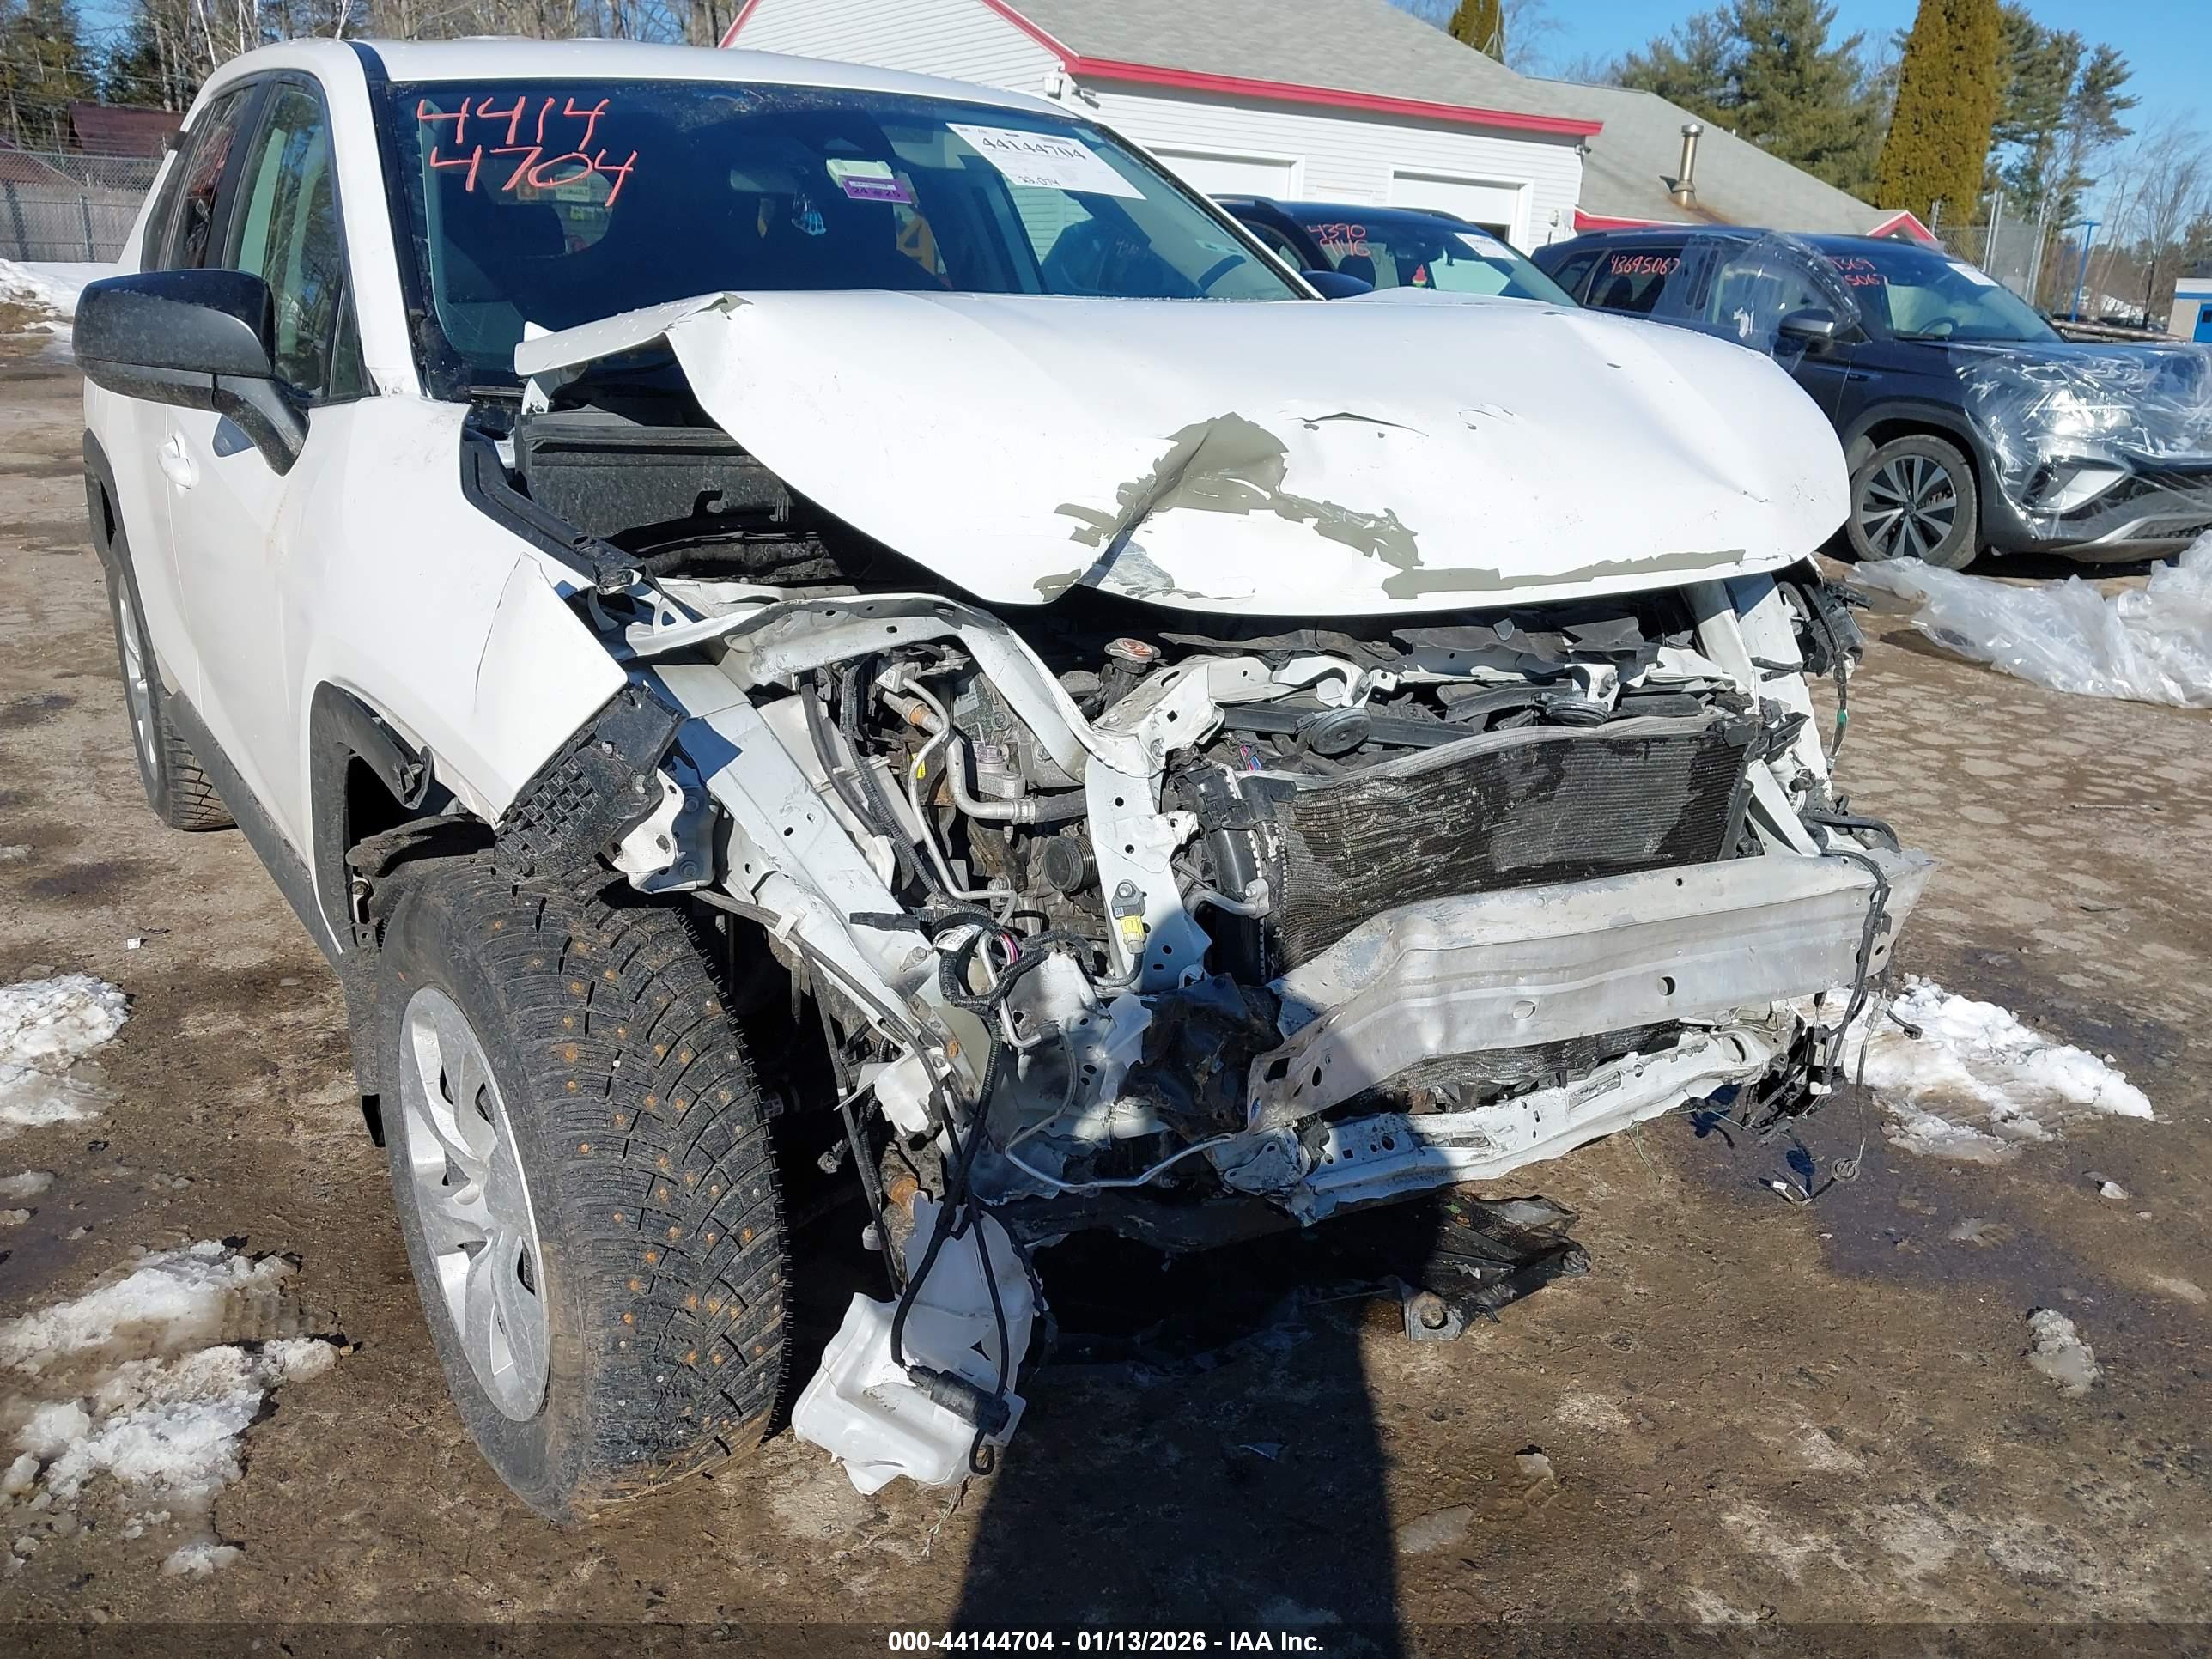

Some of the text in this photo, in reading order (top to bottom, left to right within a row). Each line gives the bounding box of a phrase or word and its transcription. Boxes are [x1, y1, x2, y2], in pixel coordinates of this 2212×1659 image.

[417, 96, 611, 149] 4414
[981, 137, 1087, 161] 44144704
[429, 144, 638, 207] 4704
[1306, 223, 1366, 240] 4390
[1611, 254, 1680, 275] 43695067
